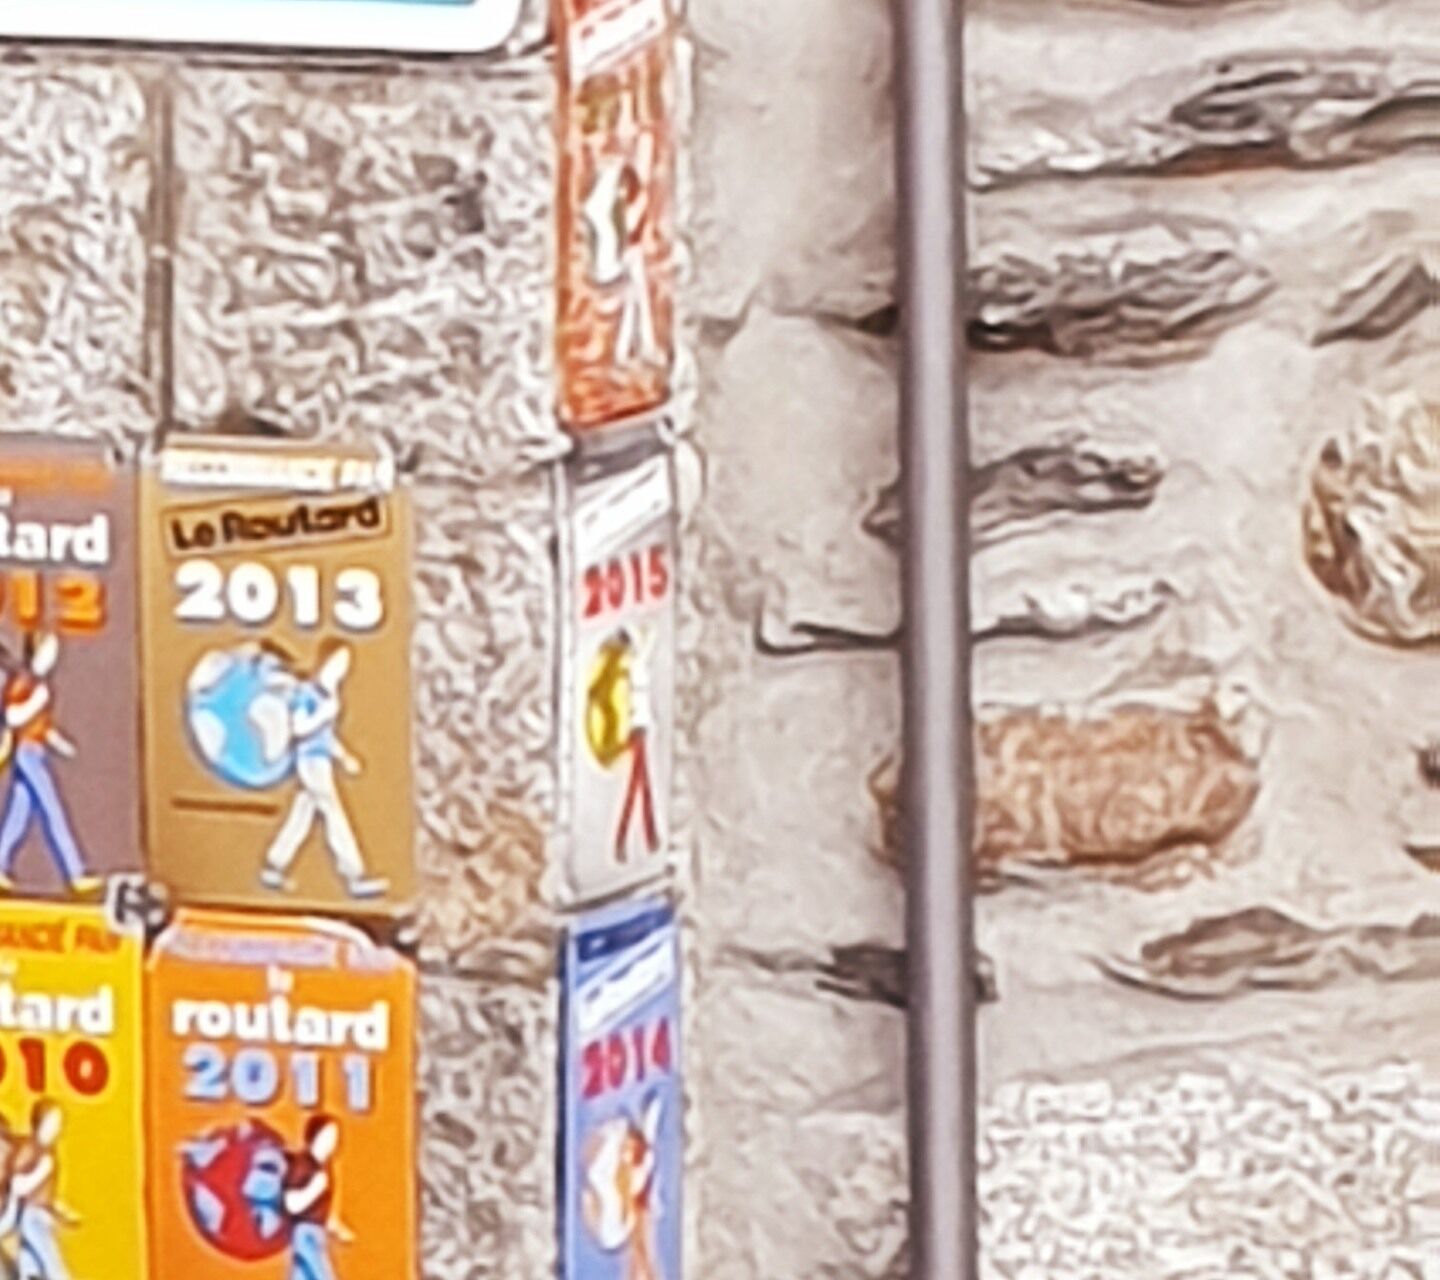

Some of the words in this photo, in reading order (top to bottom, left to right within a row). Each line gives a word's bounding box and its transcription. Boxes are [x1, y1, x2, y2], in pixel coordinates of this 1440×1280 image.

[170, 515, 216, 552] Le
[219, 497, 382, 544] Routard
[173, 560, 384, 630] 2013
[584, 545, 668, 618] 2015
[172, 994, 389, 1050] routard
[182, 1044, 371, 1111] 2011
[582, 1016, 672, 1100] 2014
